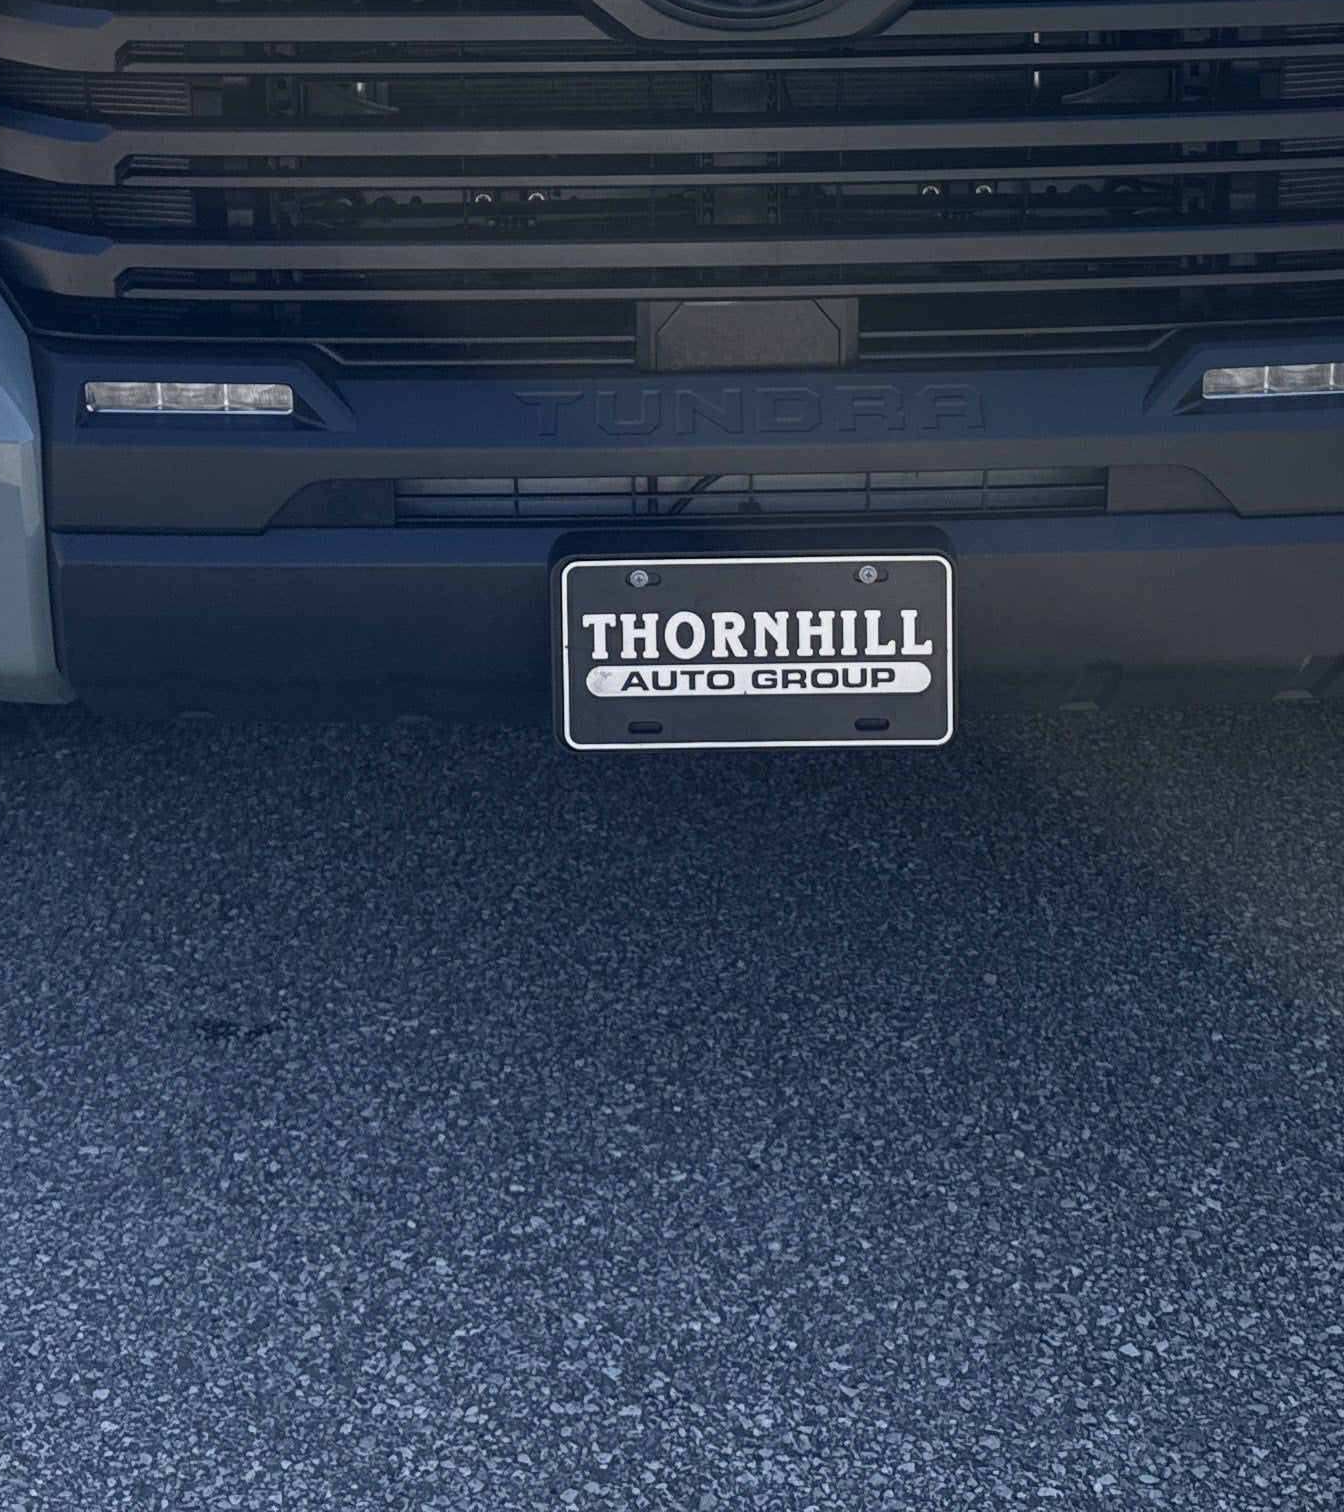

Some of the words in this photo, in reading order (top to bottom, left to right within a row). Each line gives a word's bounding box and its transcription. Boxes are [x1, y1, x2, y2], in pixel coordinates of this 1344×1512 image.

[513, 384, 986, 436] TUNDRA
[581, 609, 933, 660] THORNHILL
[620, 669, 736, 692] AUTO
[751, 667, 897, 690] GROUP
